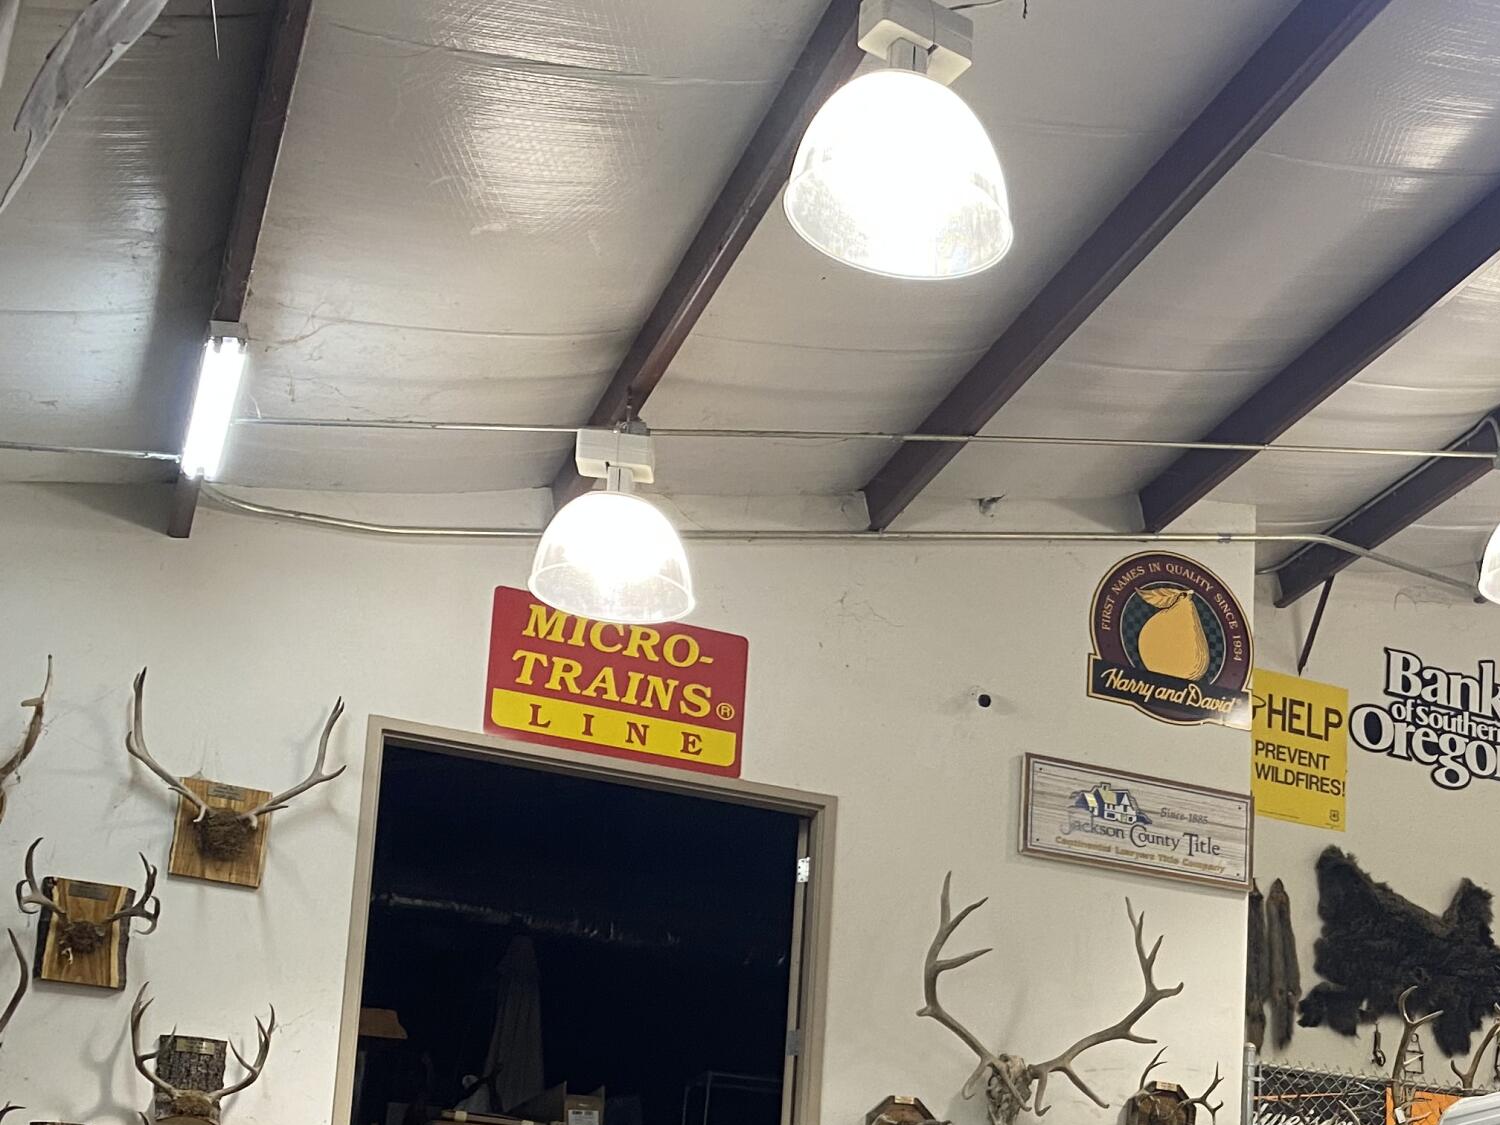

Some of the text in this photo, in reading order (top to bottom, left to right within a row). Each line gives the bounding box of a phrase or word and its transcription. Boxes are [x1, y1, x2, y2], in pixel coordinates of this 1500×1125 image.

[1101, 562, 1242, 661] FIRST NAMES IN QUALITY SINCE 1934
[521, 603, 714, 668] MICRO-
[1101, 668, 1234, 713] Harry and David
[1391, 699, 1414, 722] of
[1266, 693, 1344, 742] HELP
[1254, 740, 1330, 772] PREVENT
[1254, 761, 1346, 797] WILDFIRES!
[1060, 807, 1221, 857] Jackson County Title
